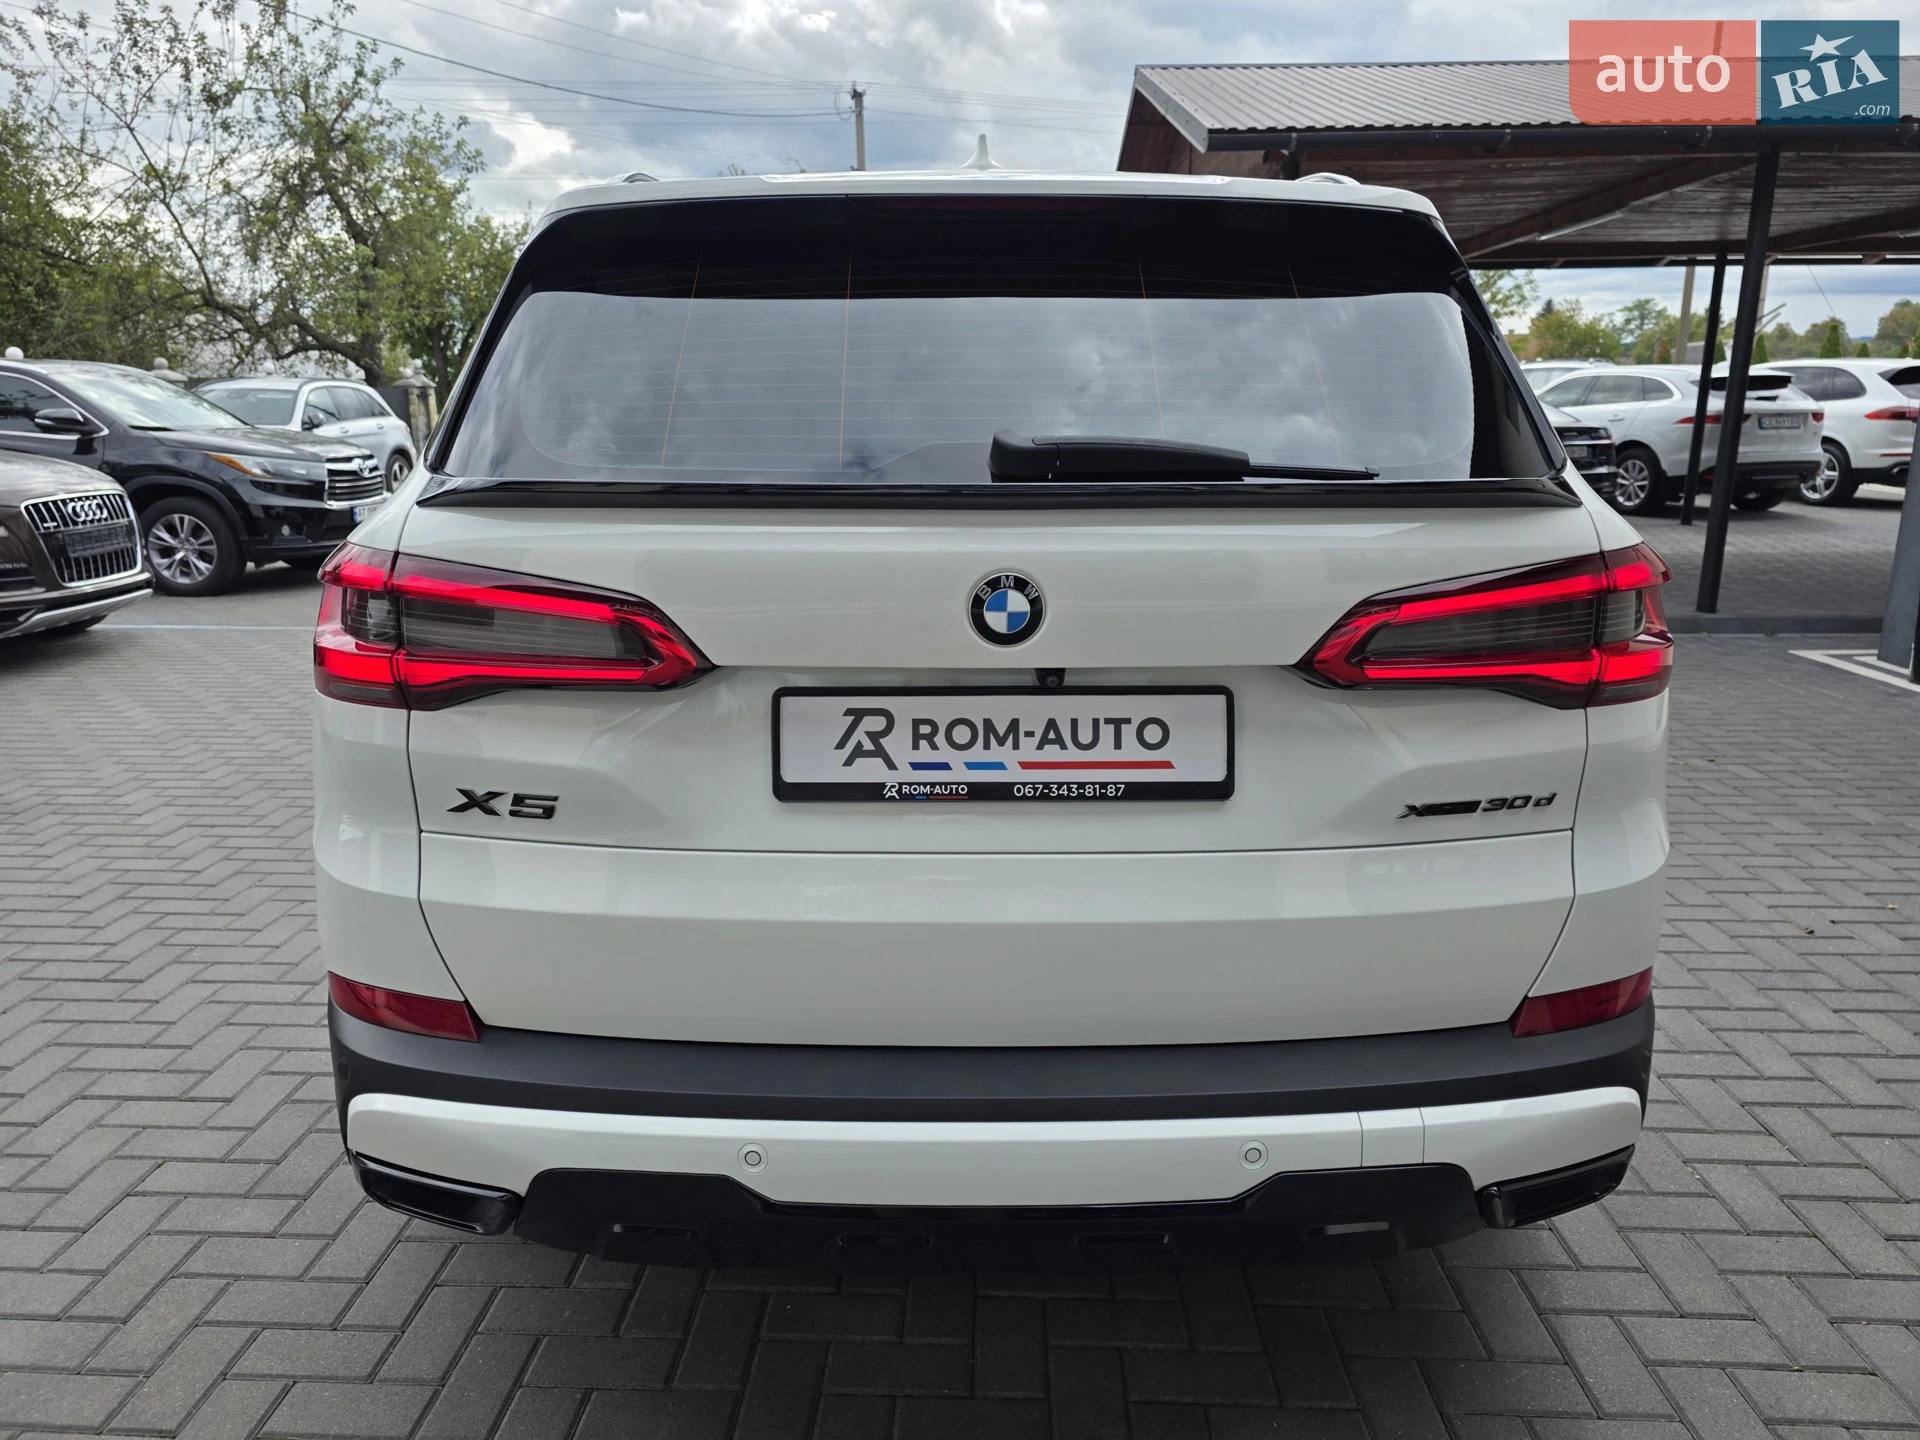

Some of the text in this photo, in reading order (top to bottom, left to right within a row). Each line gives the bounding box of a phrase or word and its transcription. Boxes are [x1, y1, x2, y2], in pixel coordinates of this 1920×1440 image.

[977, 575, 1038, 600] BMW
[911, 716, 1171, 752] ROM-AUTO
[902, 784, 968, 795] ROM-AUTO
[1013, 784, 1126, 798] 067-343-81-87
[446, 788, 560, 820] X5
